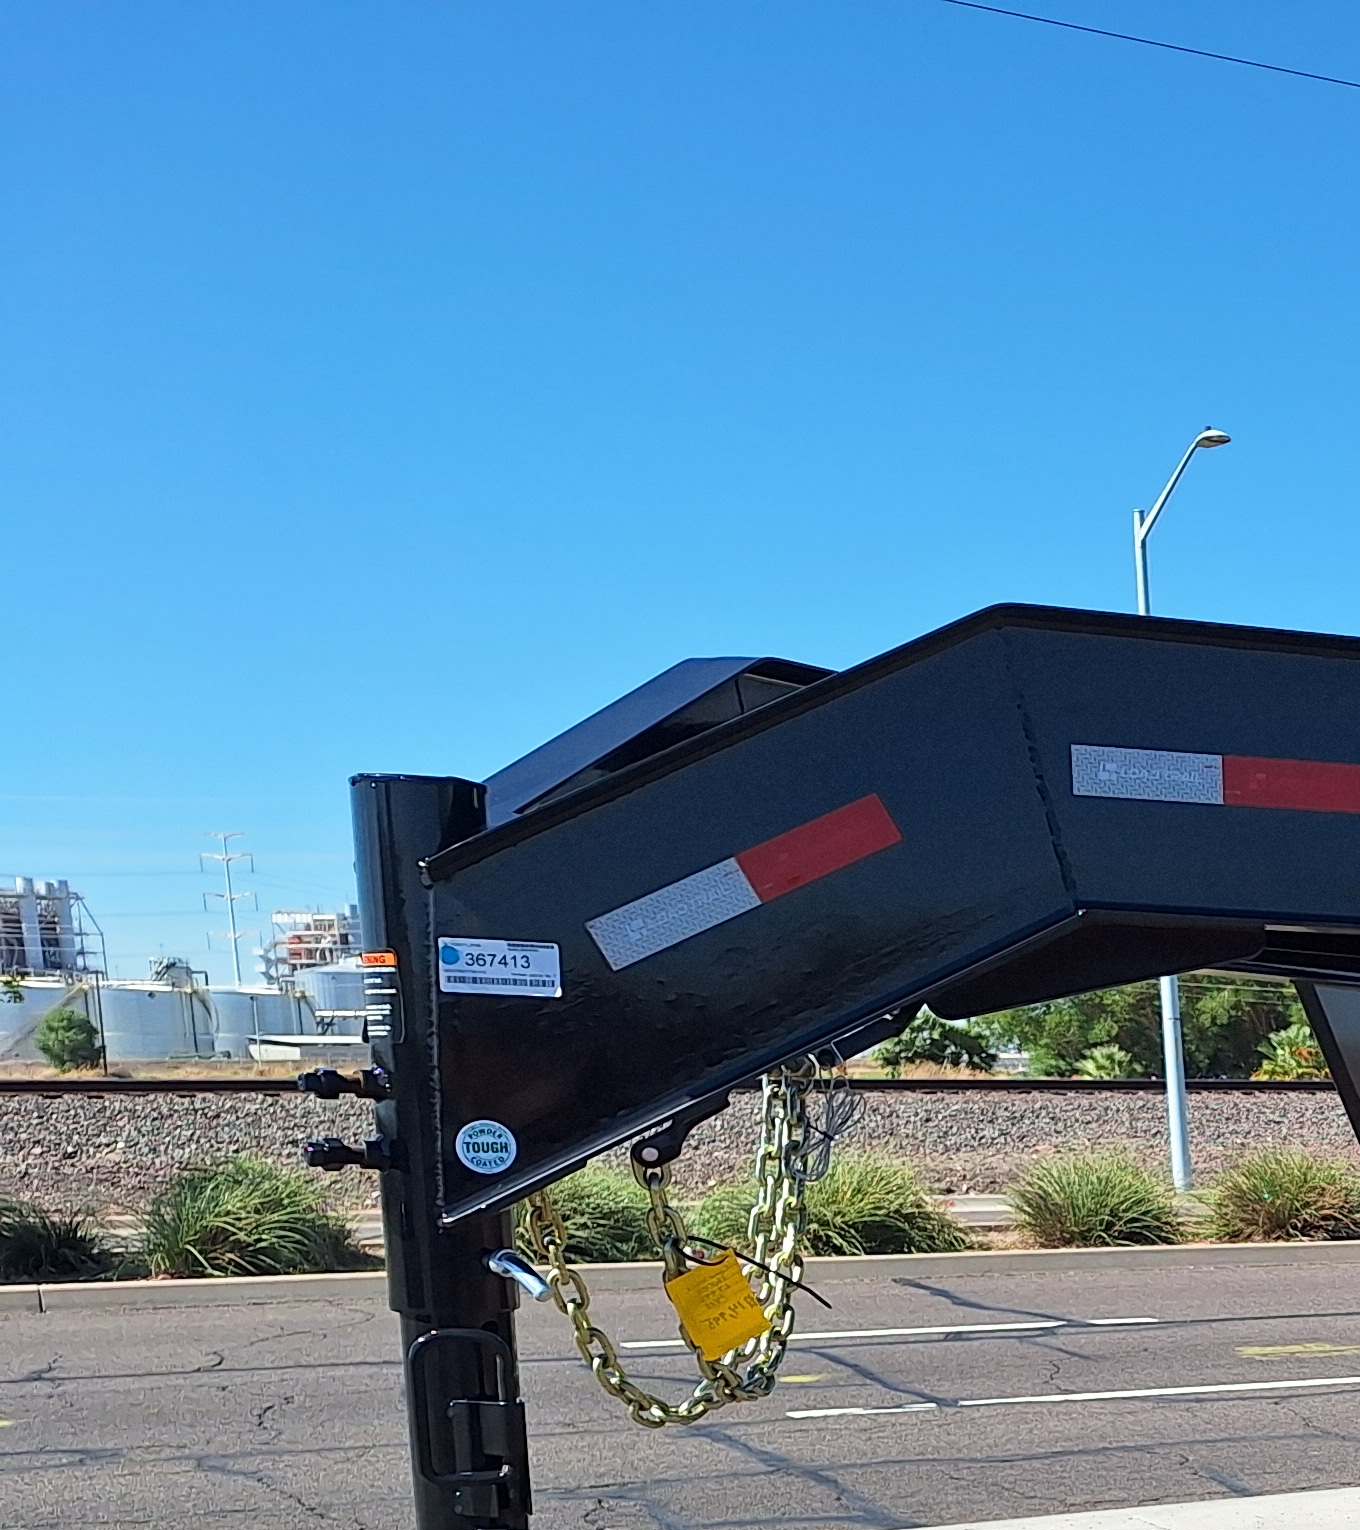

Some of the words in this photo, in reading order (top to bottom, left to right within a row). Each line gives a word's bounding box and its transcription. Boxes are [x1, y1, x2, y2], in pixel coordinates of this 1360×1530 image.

[464, 952, 531, 969] 367413
[467, 1128, 503, 1140] POWDER
[463, 1141, 509, 1154] TOUGH
[470, 1155, 505, 1168] COATED
